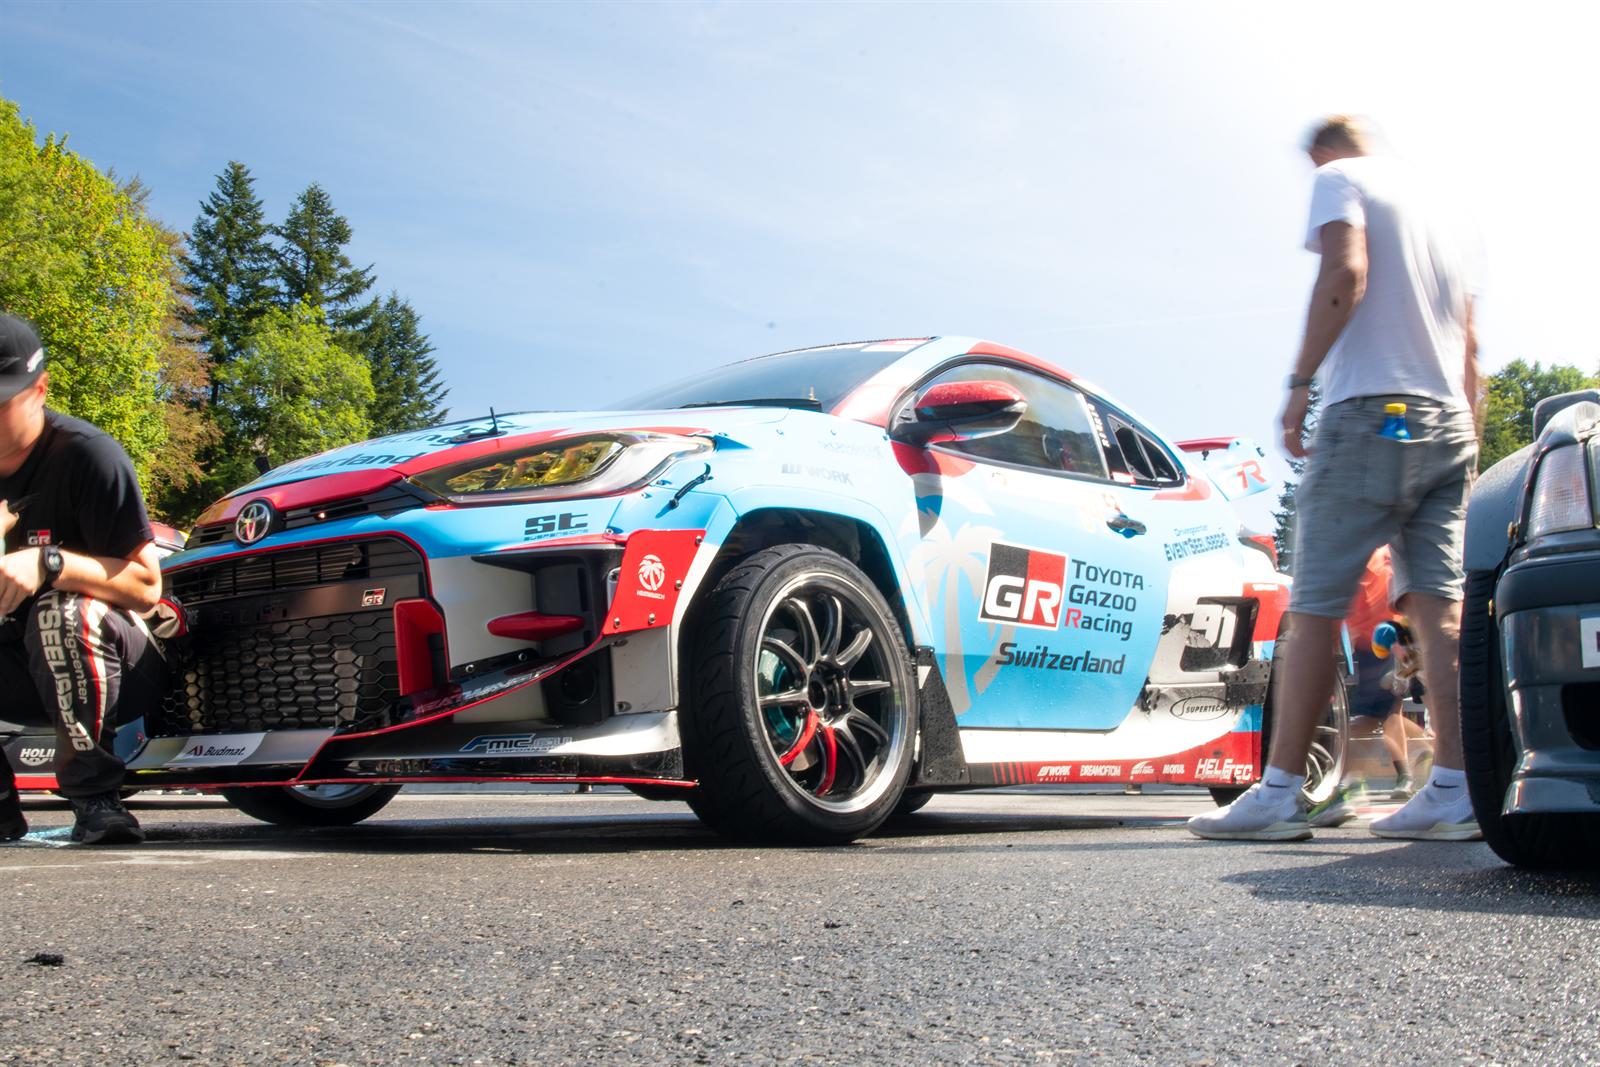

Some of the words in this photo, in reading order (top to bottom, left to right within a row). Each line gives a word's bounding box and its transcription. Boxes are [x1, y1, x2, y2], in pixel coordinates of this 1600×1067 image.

[1071, 558, 1145, 591] TOYOTA
[363, 594, 384, 605] GR
[984, 574, 1062, 625] GR
[1068, 584, 1137, 612] GAZOO
[1064, 608, 1133, 641] Racing
[995, 641, 1127, 675] Switzerland
